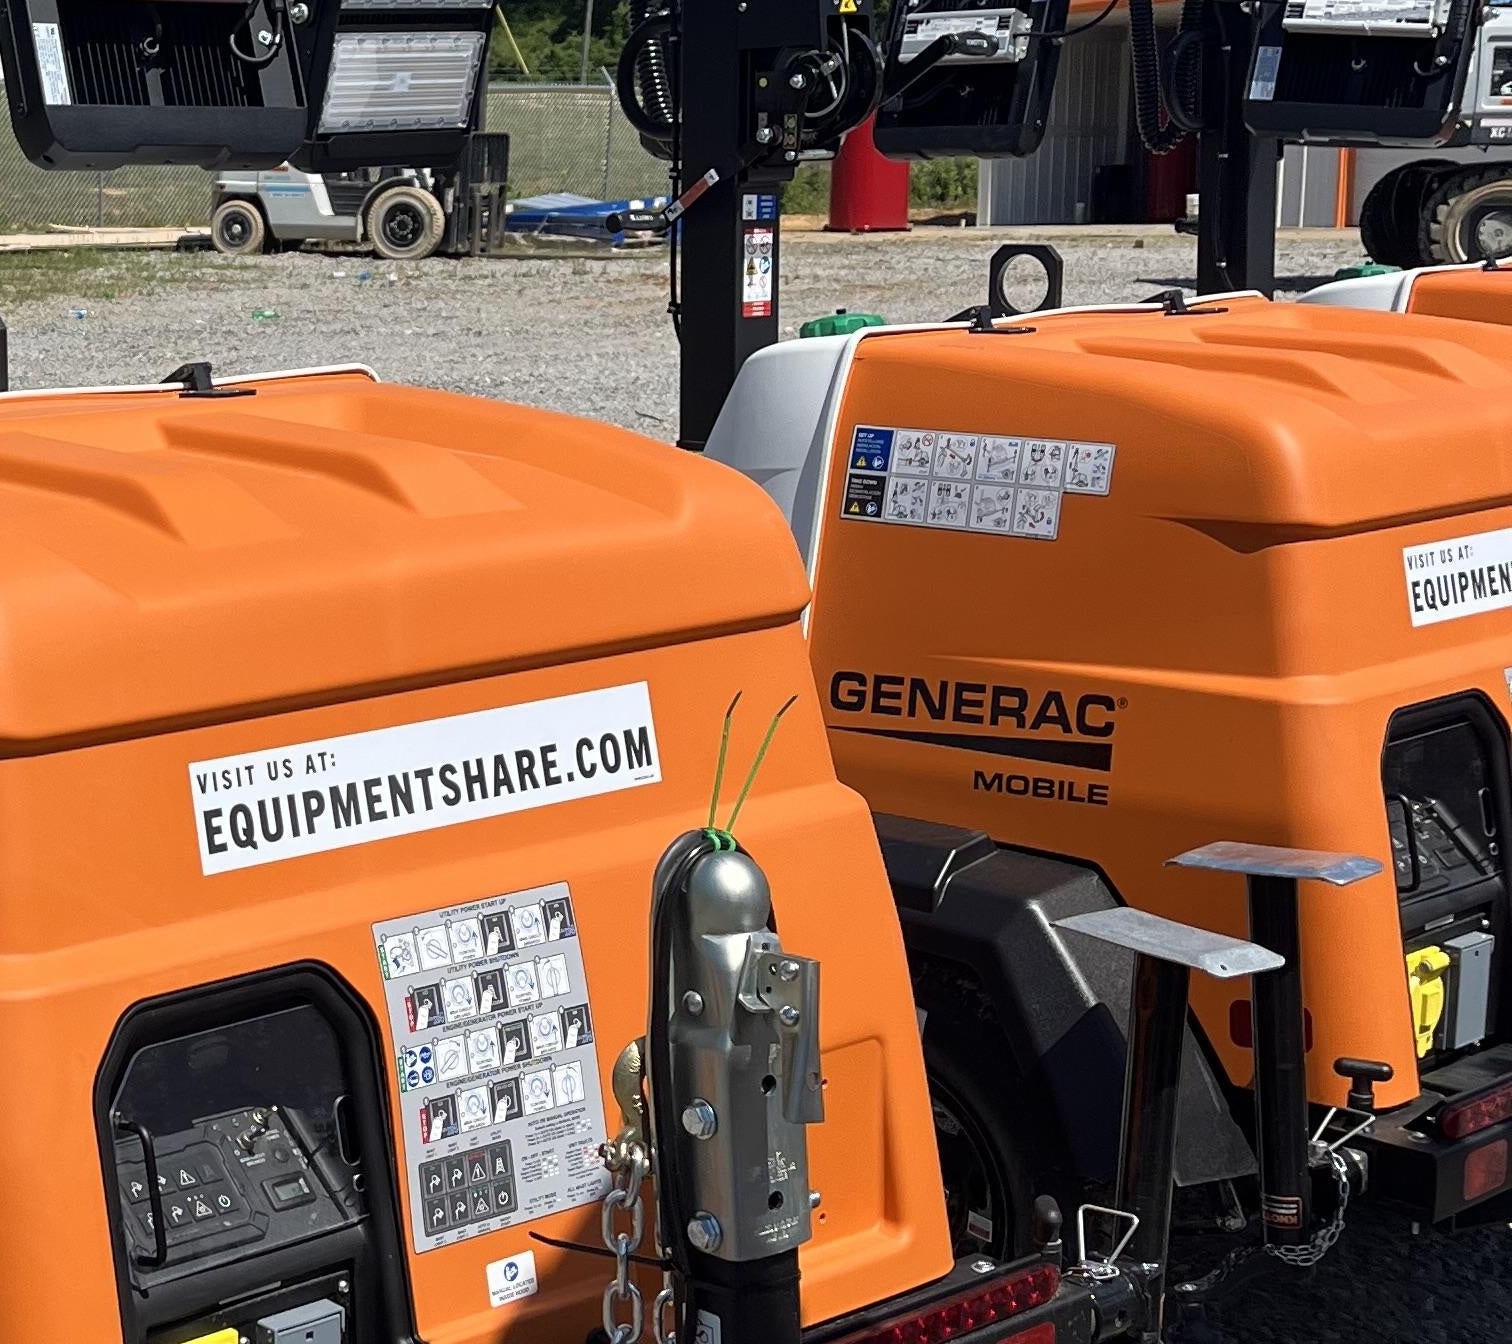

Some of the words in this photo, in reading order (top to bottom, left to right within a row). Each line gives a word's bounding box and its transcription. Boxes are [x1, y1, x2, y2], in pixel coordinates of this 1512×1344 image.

[1407, 552, 1434, 570] VISIT
[1440, 548, 1453, 564] US
[1411, 561, 1512, 613] EQUIPMEN
[830, 671, 1116, 738] GENERAC
[196, 764, 255, 795] VISIT
[267, 757, 294, 780] US
[305, 751, 337, 775] AT:
[202, 725, 655, 855] EQUIPMENTSHARE.COM
[973, 770, 1110, 806] MOBILE
